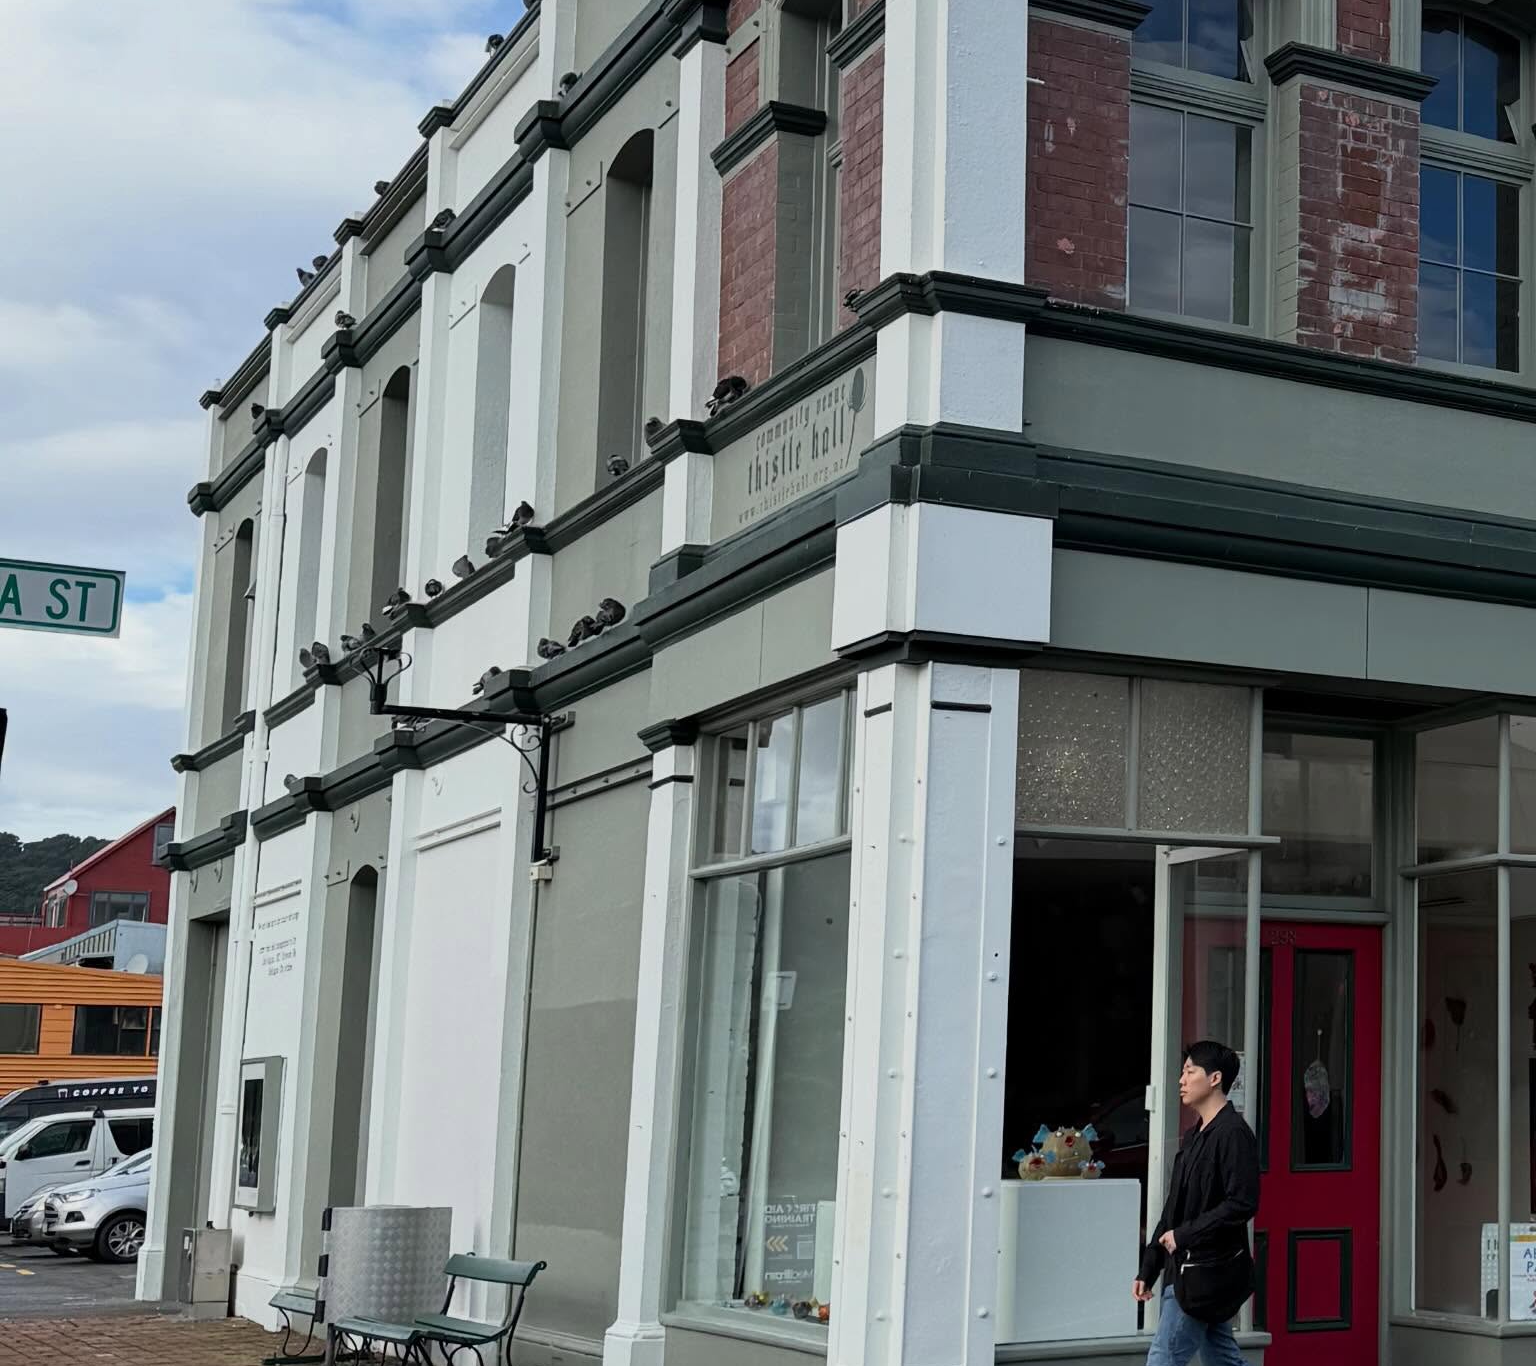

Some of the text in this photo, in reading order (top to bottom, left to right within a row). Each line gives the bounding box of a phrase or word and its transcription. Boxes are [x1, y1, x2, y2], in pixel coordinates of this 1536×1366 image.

[748, 402, 845, 496] thistle hall
[45, 578, 97, 622] ST
[73, 1086, 125, 1097] COFFEE
